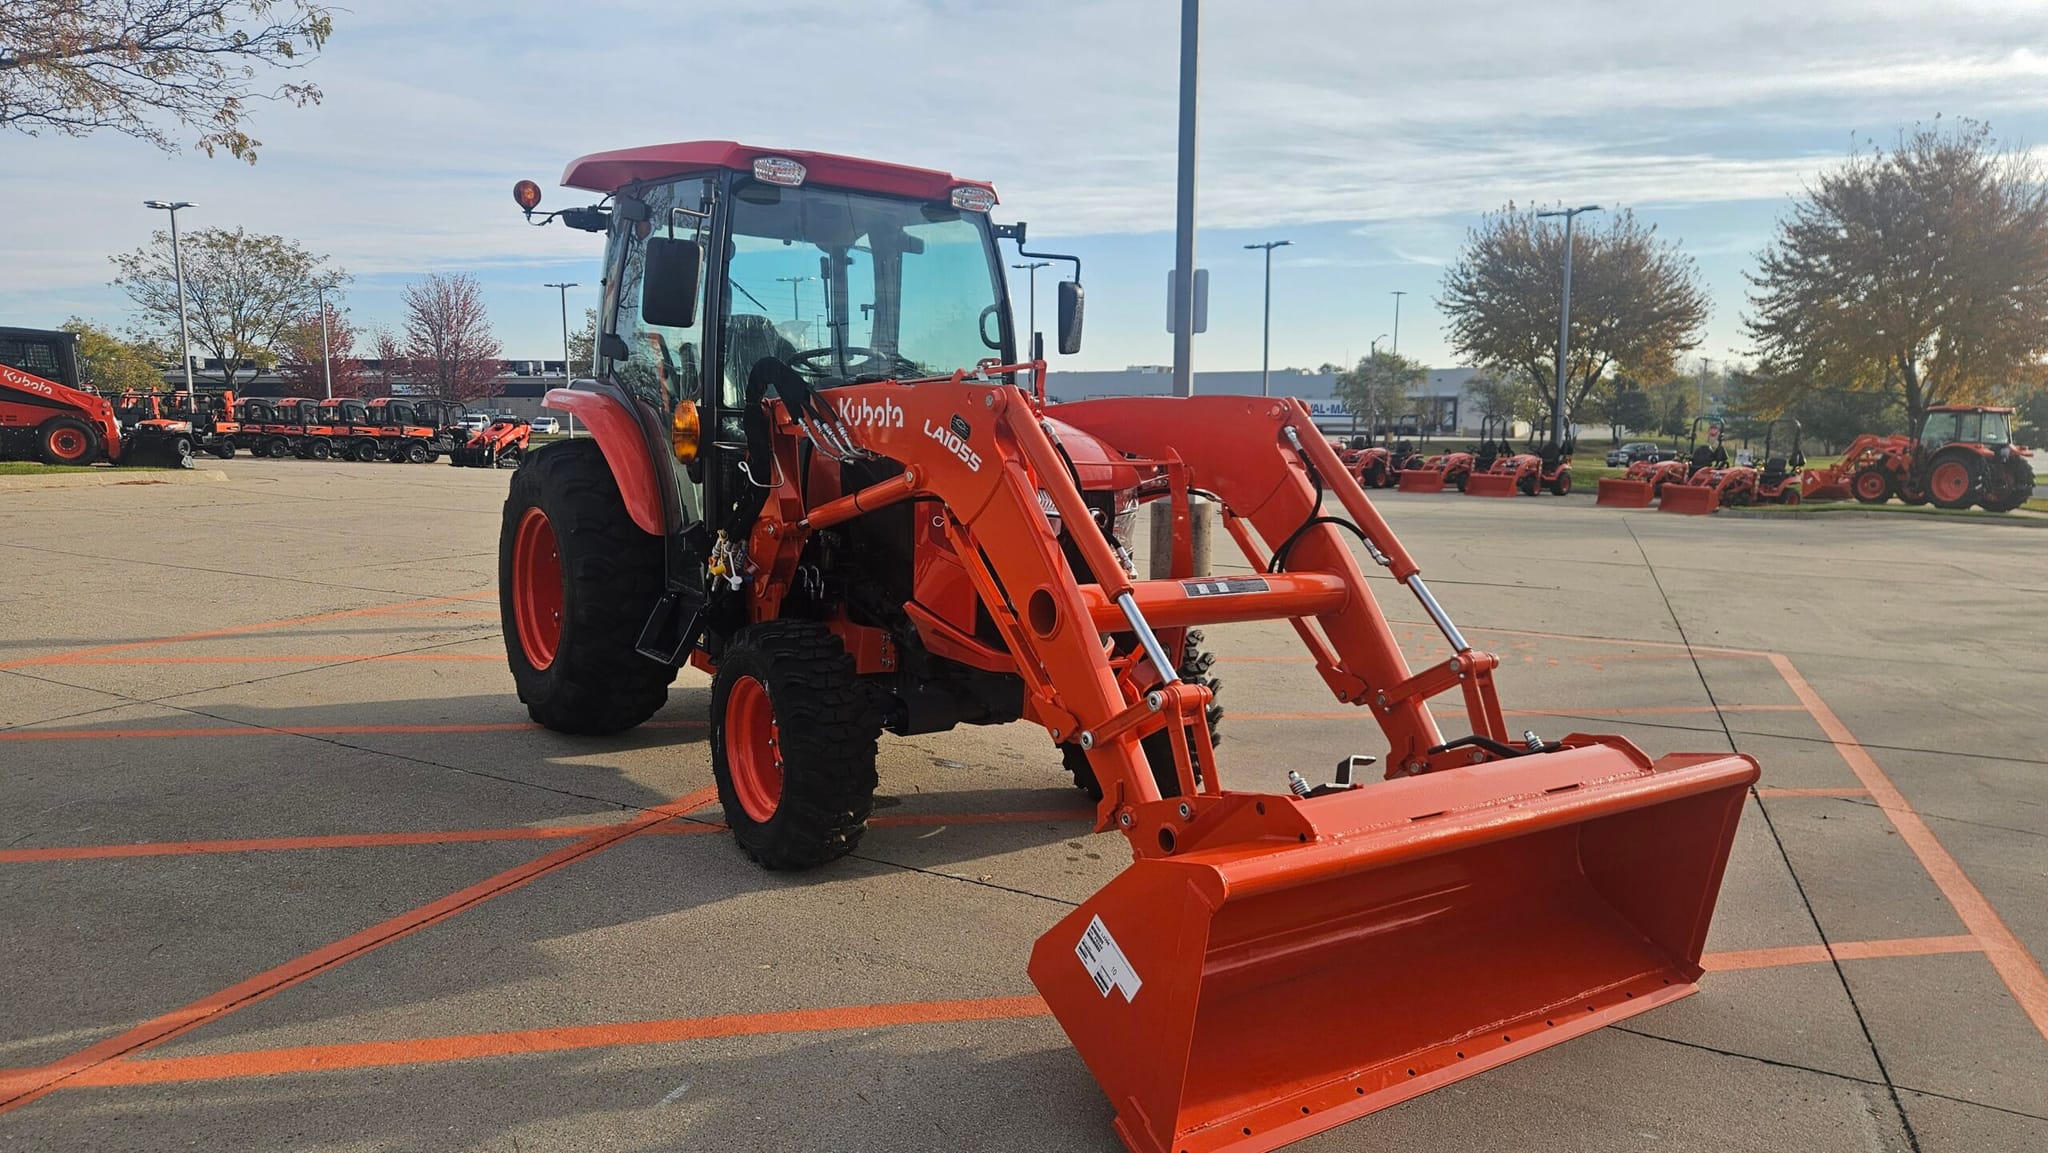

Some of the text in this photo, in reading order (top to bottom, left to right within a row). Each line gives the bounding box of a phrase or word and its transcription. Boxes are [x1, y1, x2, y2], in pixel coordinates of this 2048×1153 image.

[3, 369, 53, 394] Kubota
[839, 397, 904, 427] Kubota
[923, 418, 982, 472] LA1055
